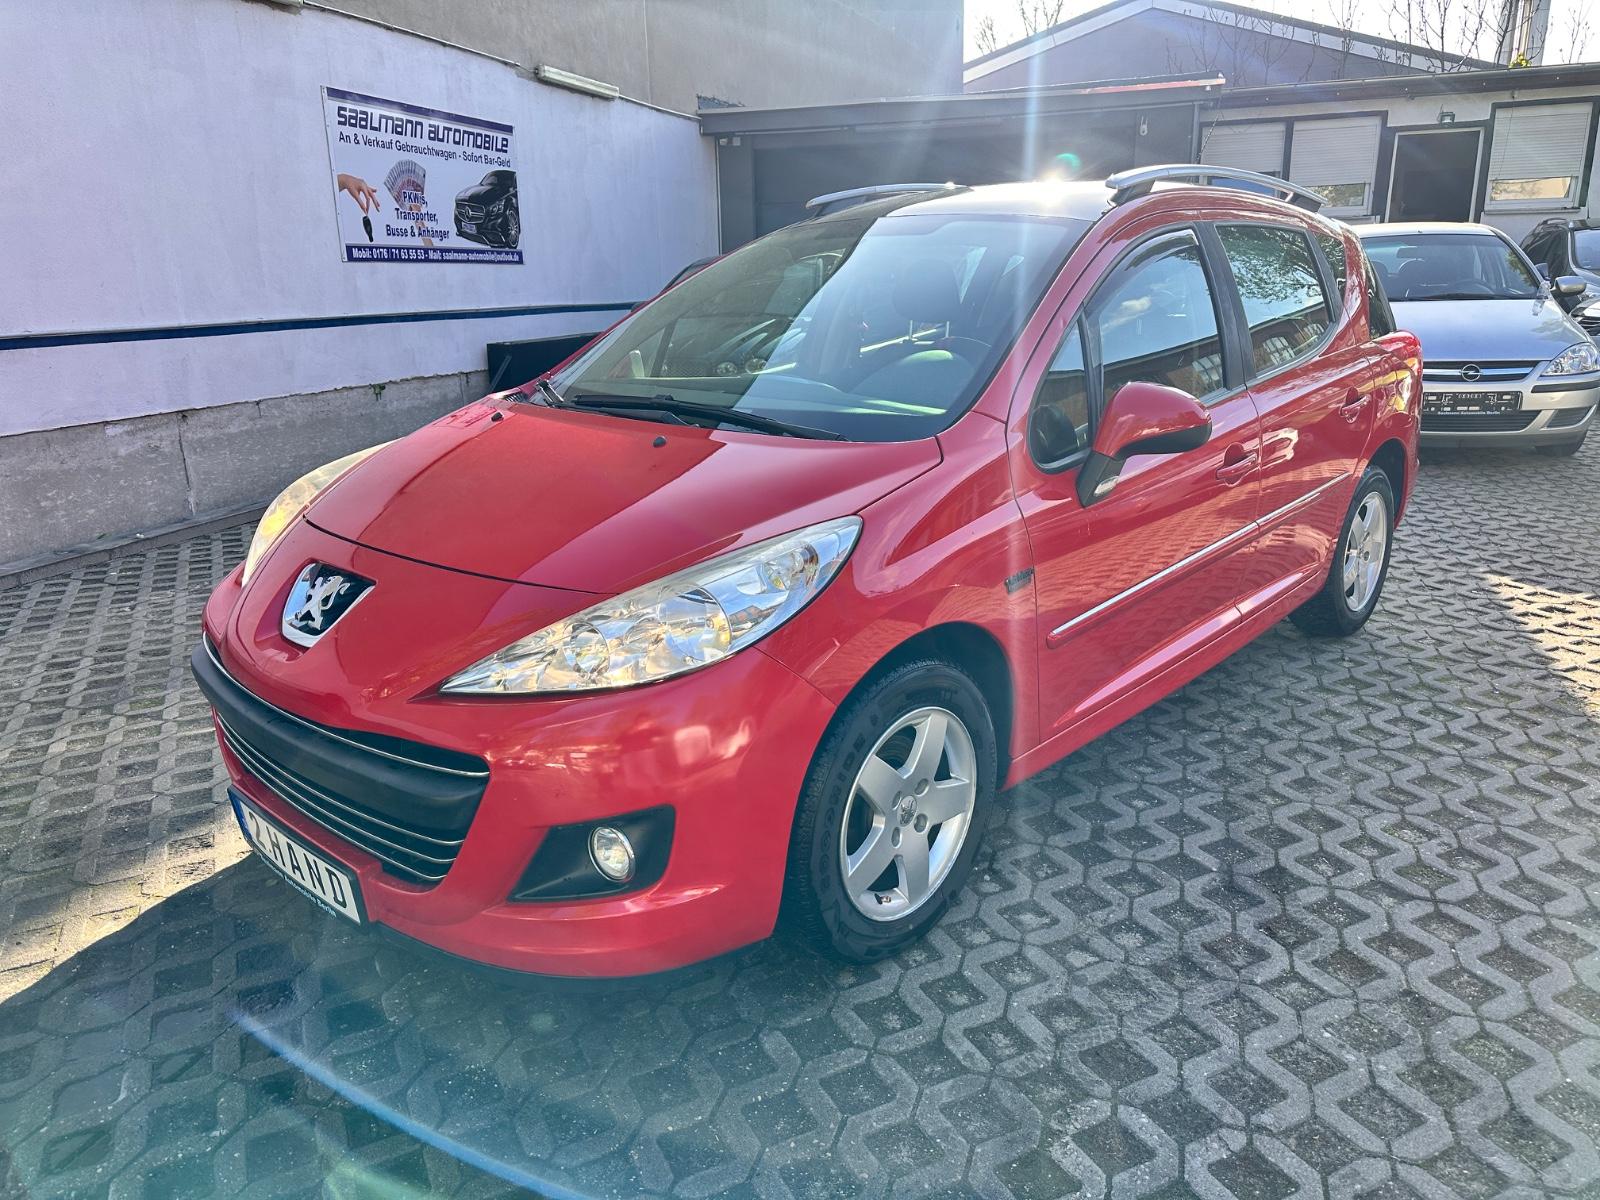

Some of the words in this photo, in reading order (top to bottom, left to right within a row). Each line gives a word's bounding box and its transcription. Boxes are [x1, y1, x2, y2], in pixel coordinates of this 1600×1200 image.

[339, 131, 351, 144] An
[353, 133, 361, 145] &
[361, 134, 394, 150] Verkauf
[394, 140, 457, 160] Gebrauchtwagen
[462, 151, 483, 164] Sofort
[484, 155, 511, 168] Bar-Geld
[394, 207, 439, 225] Transporter,
[385, 224, 409, 237] Busse
[410, 225, 416, 237] &
[417, 226, 450, 241] Anhänger
[352, 248, 372, 259] Mobil:
[372, 248, 388, 259] 0176
[392, 249, 400, 259] 71
